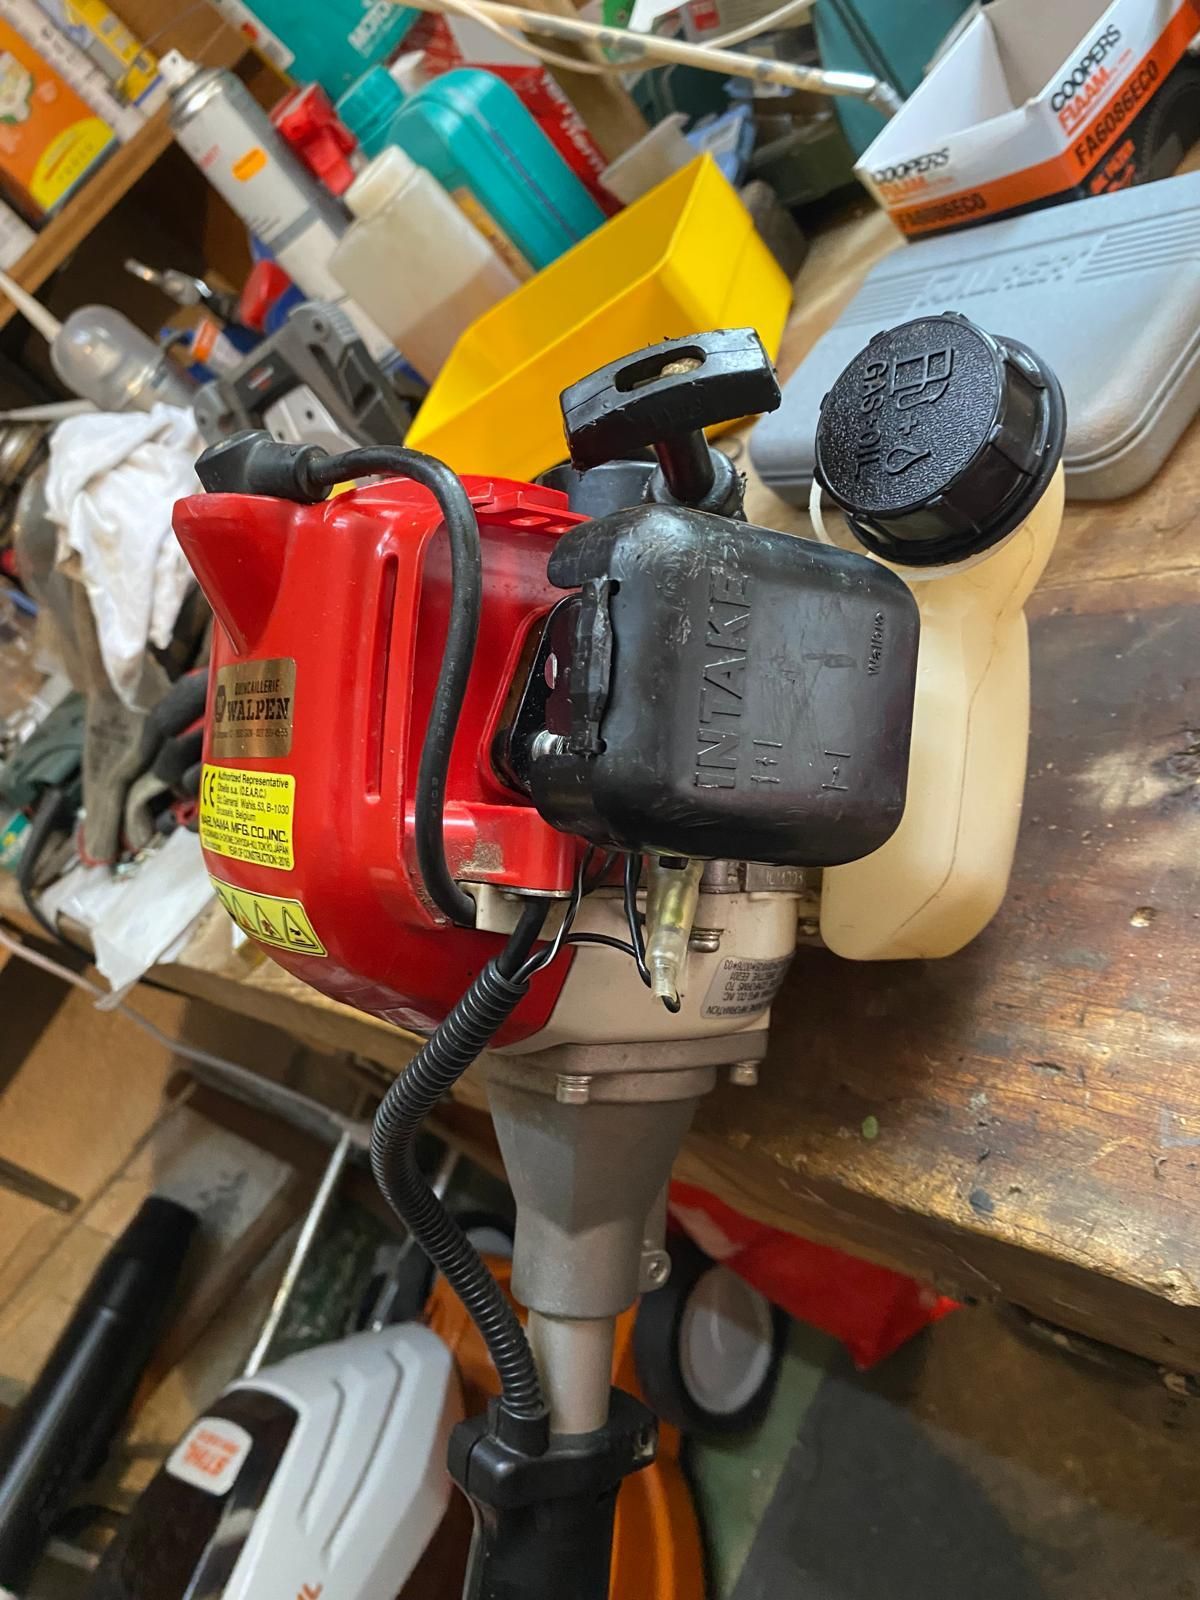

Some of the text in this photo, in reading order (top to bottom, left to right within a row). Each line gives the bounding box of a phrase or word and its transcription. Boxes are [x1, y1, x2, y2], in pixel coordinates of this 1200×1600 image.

[1051, 24, 1121, 112] COOPERS
[1058, 66, 1110, 132] FIAAM
[694, 572, 751, 790] INTAKE
[227, 698, 290, 722] WALPEN
[218, 771, 289, 788] Authorized Representative
[235, 809, 256, 823] Belgium
[267, 802, 289, 815] B-1030
